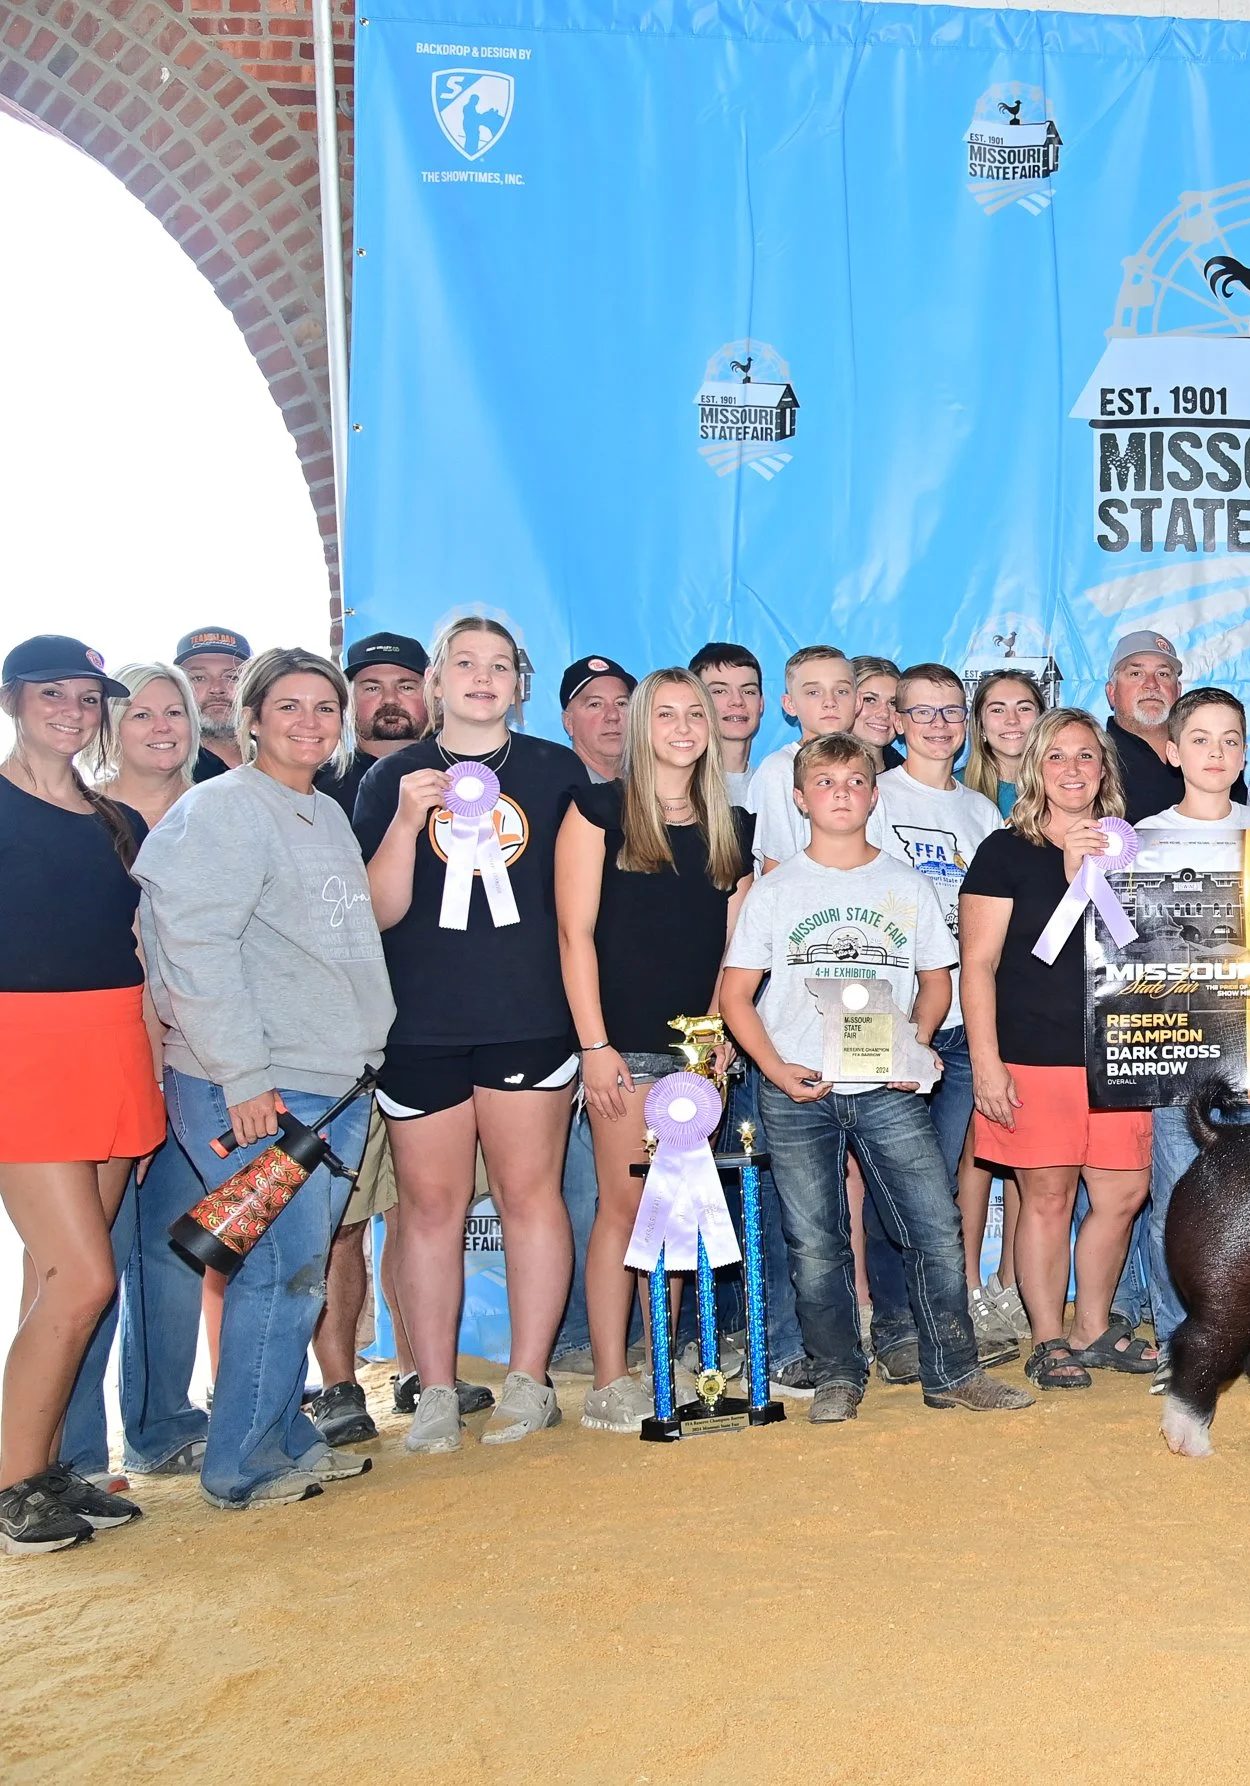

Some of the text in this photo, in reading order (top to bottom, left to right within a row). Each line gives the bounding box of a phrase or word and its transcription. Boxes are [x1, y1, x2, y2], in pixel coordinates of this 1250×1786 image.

[416, 42, 532, 60] BACKDROP & DESIGN BY
[970, 132, 1004, 145] EST. 1901
[970, 145, 1041, 165] MISSOURI
[422, 171, 525, 185] THE SHOWTIMES, INC.
[969, 162, 1041, 180] STATE FAIR
[701, 395, 736, 405] EST. 1901
[1100, 386, 1228, 415] EST. 1901
[701, 408, 773, 426] MISSOURI
[700, 425, 773, 442] STATE FAIR
[916, 842, 947, 861] FFA
[322, 875, 371, 928] Sloa
[788, 907, 908, 949] MISSOURI STATE FAIR
[816, 968, 877, 979] 4-H EXHIBITOR
[1116, 968, 1200, 999] State Fair
[844, 1024, 862, 1032] STATE
[1107, 1014, 1188, 1028] RESERVE
[1106, 1029, 1203, 1044] CHAMPION
[1107, 1045, 1221, 1060] DARK CROSS
[1107, 1062, 1188, 1076] BARROW
